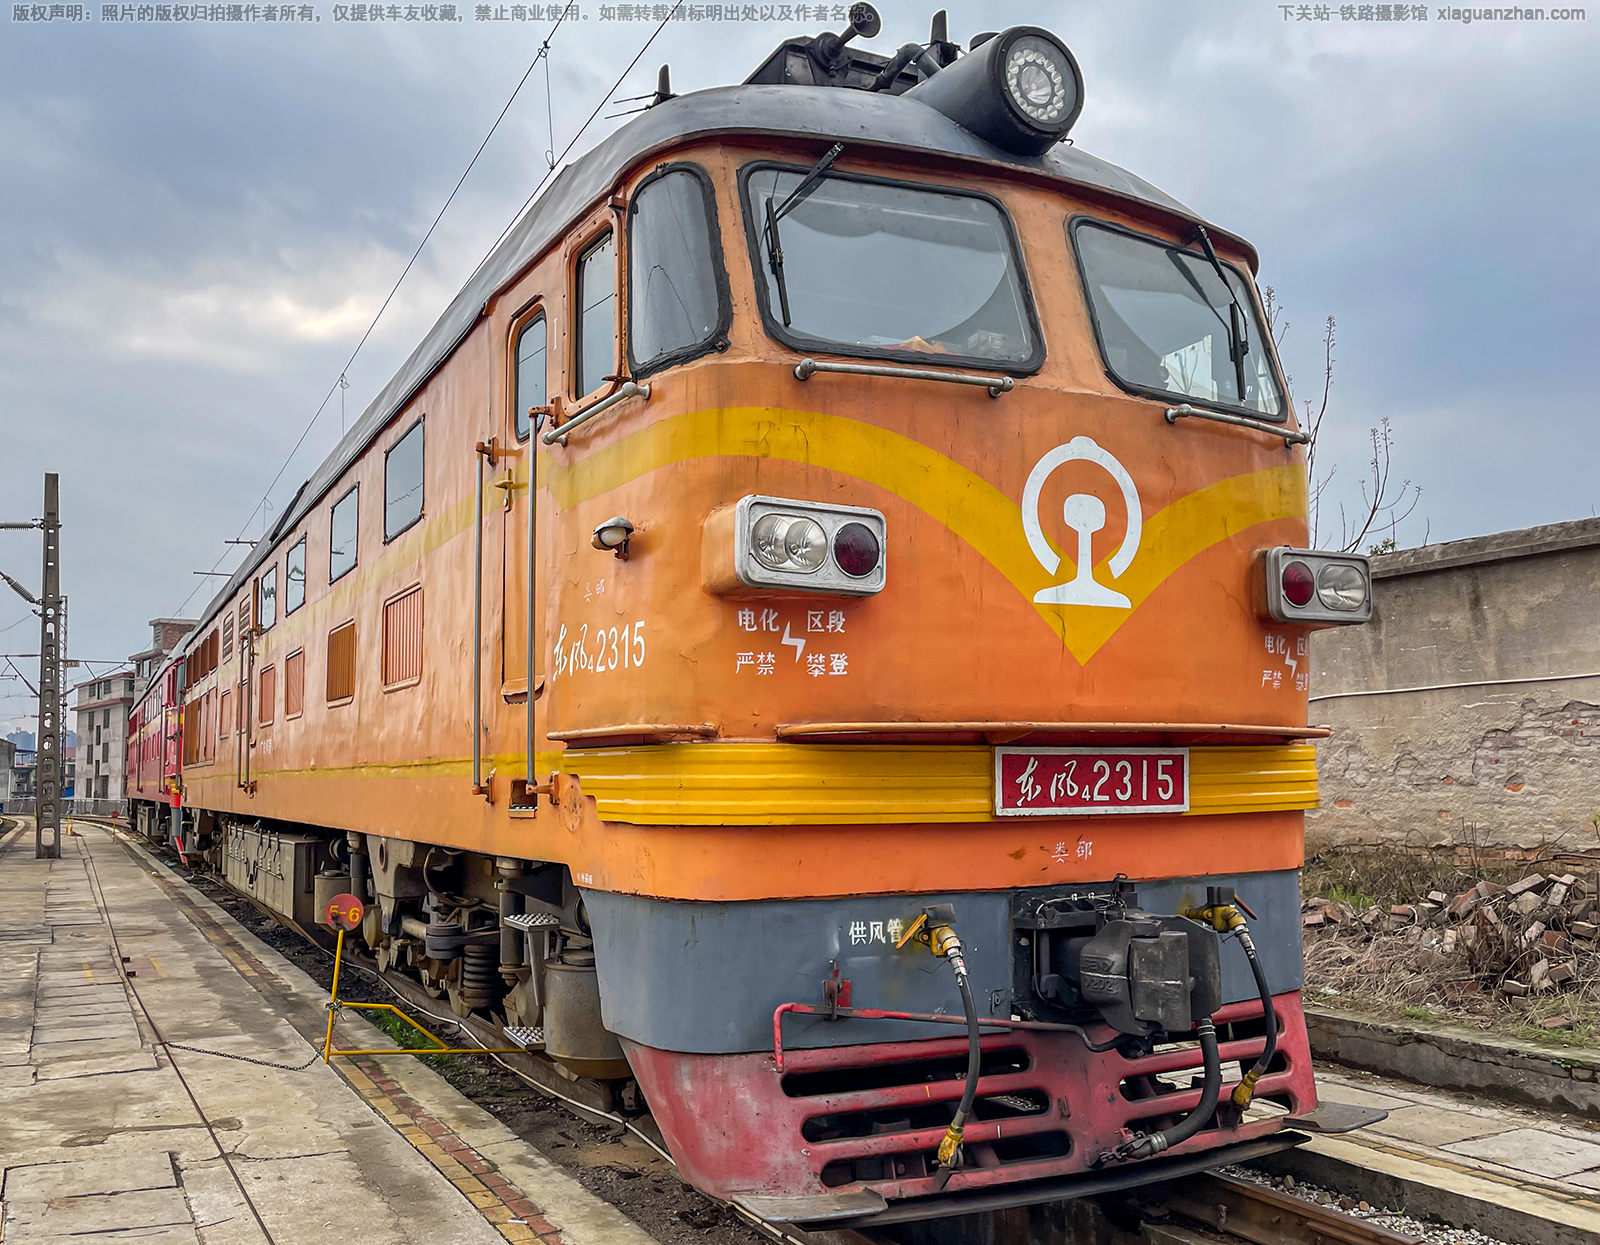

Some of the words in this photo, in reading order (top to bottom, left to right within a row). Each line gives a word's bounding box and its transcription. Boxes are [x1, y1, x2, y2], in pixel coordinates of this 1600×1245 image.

[738, 607, 780, 632] 电化
[807, 609, 846, 633] 区段
[1265, 633, 1286, 655] 电化
[1297, 636, 1309, 656] 区
[735, 651, 776, 676] 严禁
[806, 652, 849, 678] 攀登
[1261, 670, 1282, 690] 严禁
[1295, 672, 1309, 692] 攀
[848, 917, 904, 946] 供风管
